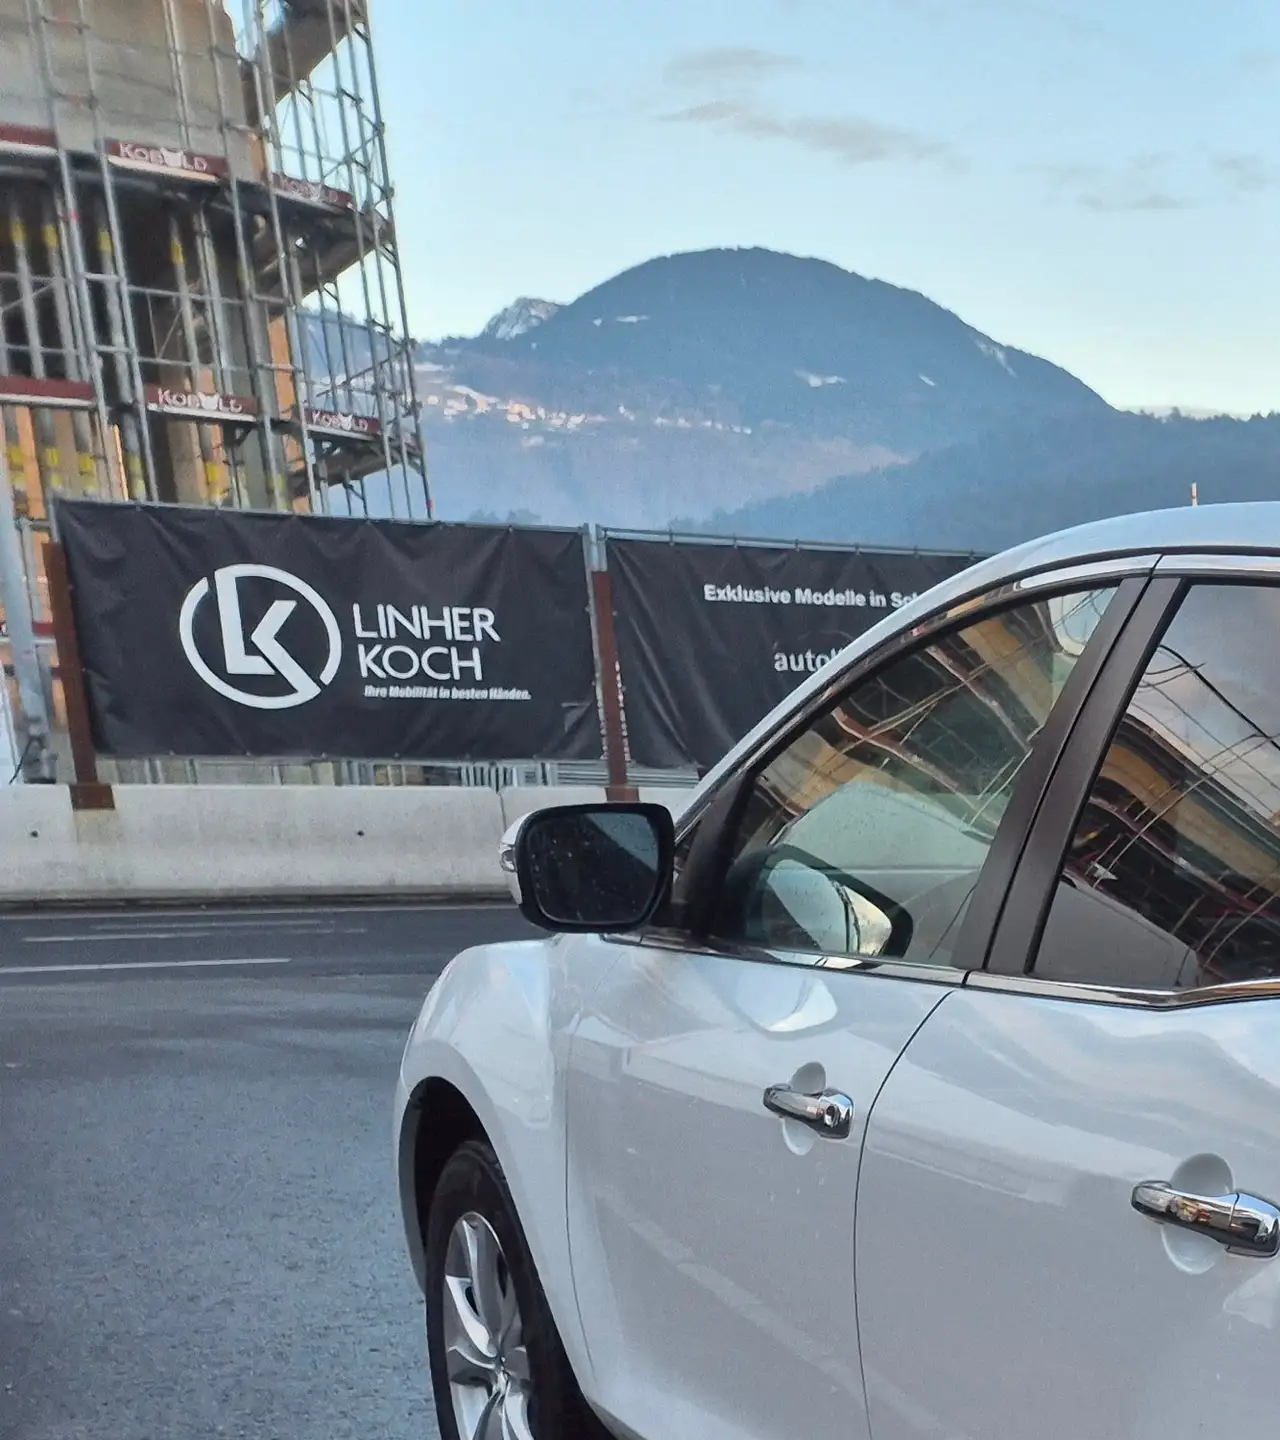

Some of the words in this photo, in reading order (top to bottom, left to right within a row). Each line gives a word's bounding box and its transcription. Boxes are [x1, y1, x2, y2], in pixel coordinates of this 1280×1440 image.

[703, 584, 791, 604] Exklusive
[794, 588, 867, 607] Modelle
[869, 590, 887, 608] in
[891, 592, 920, 609] Sc
[353, 603, 502, 642] LINHER
[357, 643, 483, 681] KOCH
